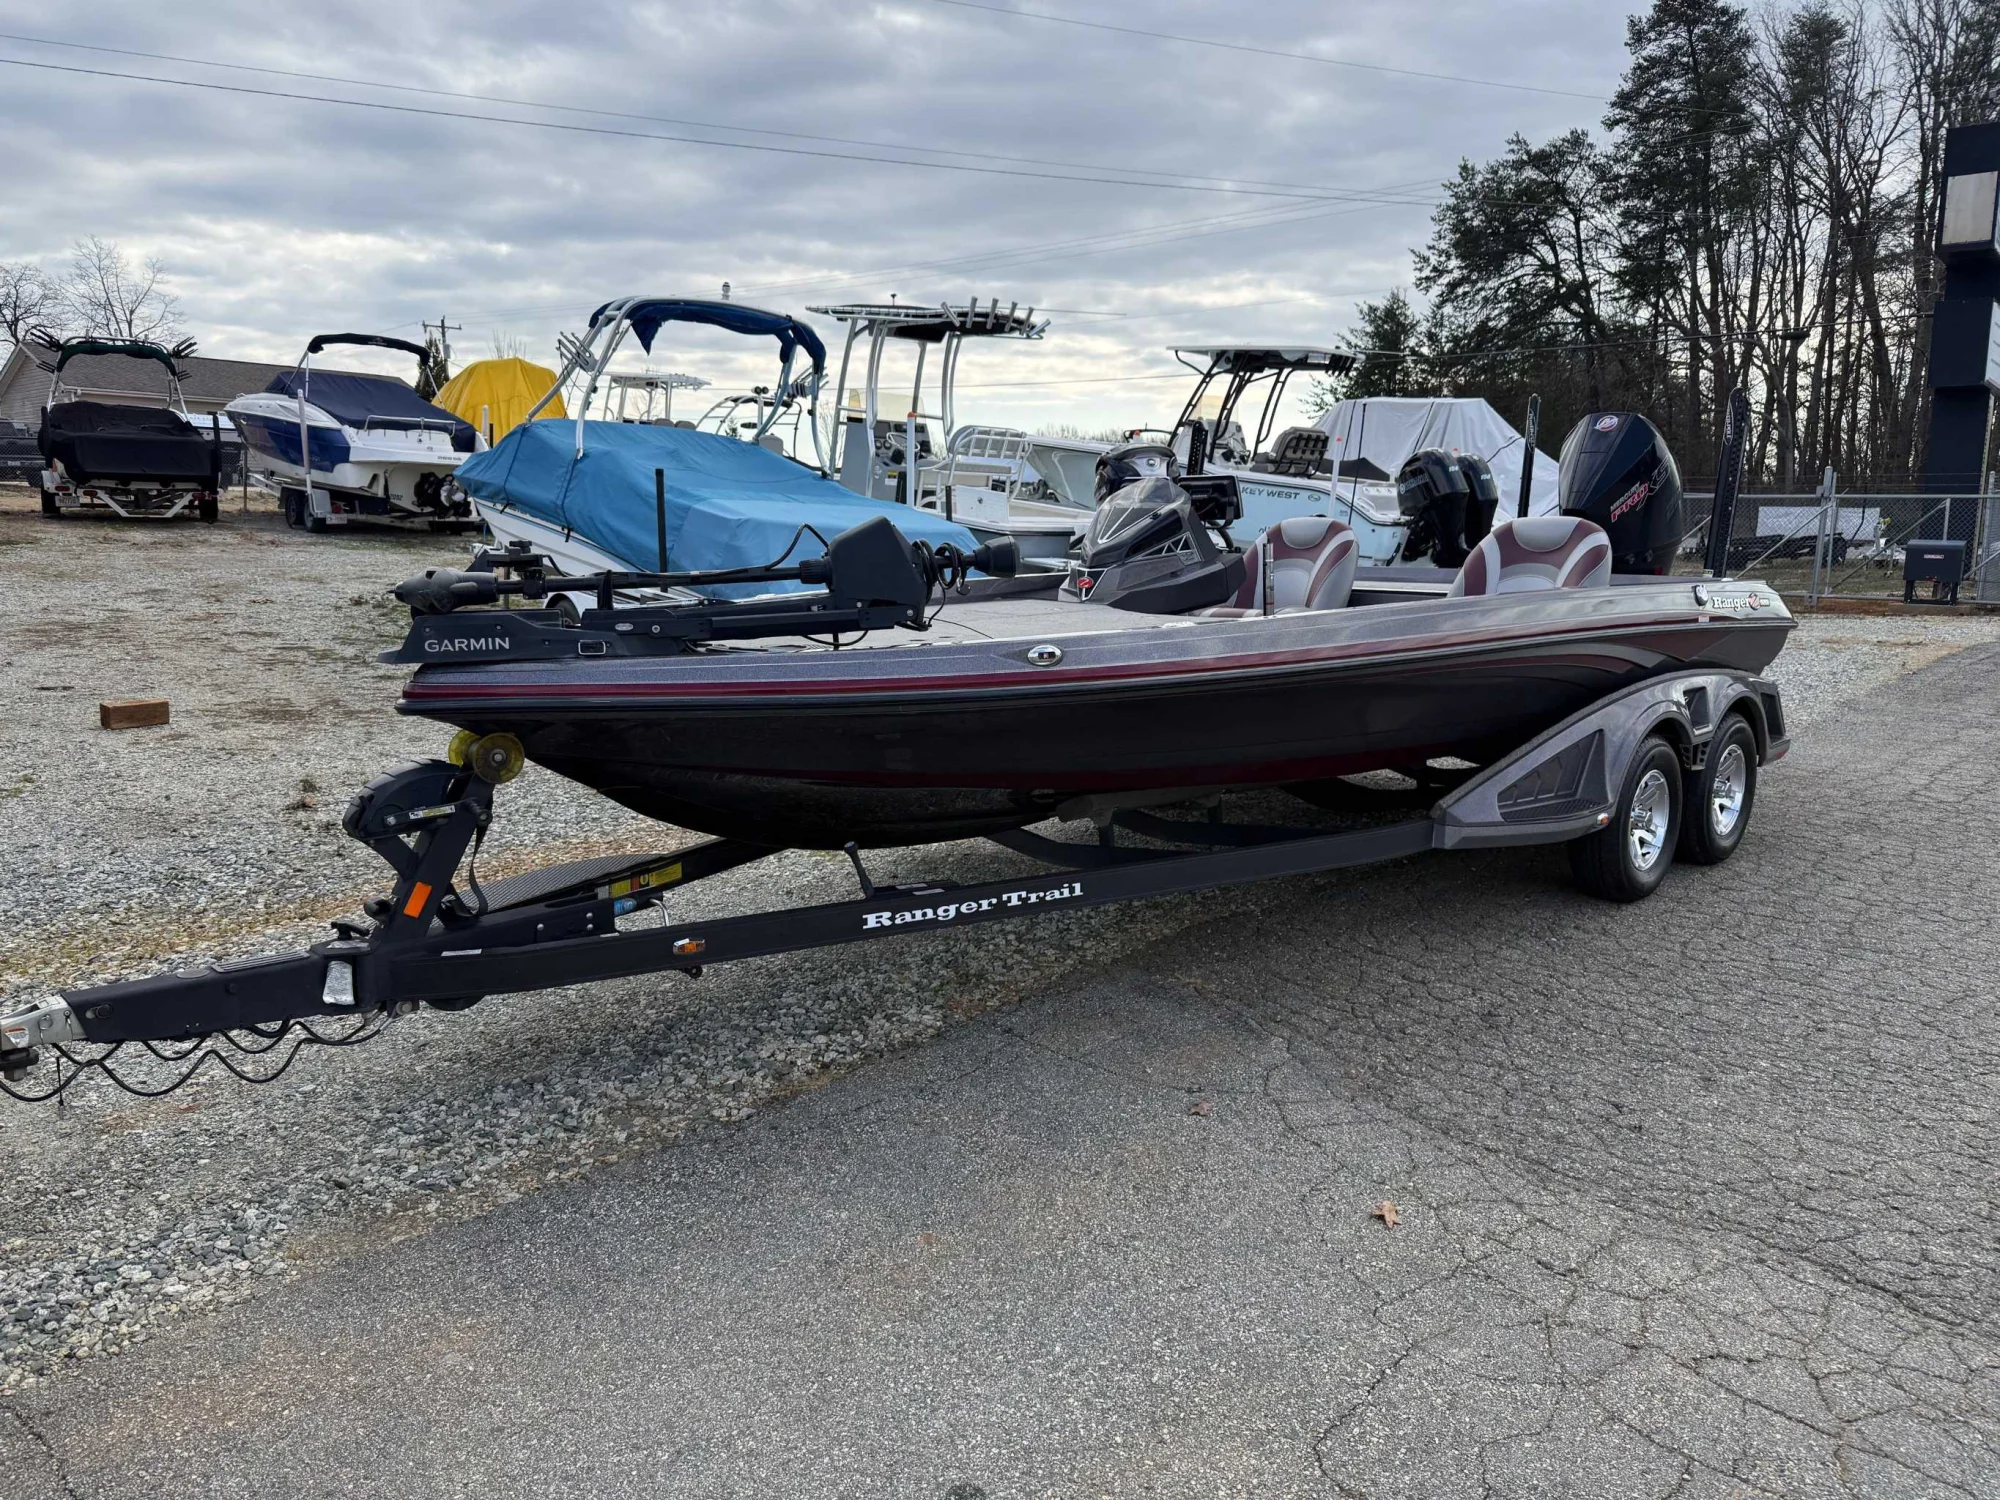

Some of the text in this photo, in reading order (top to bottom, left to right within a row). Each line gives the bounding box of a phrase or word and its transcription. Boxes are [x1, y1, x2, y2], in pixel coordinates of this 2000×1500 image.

[1241, 486, 1300, 500] KEY WEST
[1609, 481, 1640, 512] MERCURY
[1610, 482, 1649, 523] PRO
[1711, 596, 1750, 612] Ranger
[424, 637, 510, 652] GARMIN
[862, 882, 1084, 930] Ranger Trail
